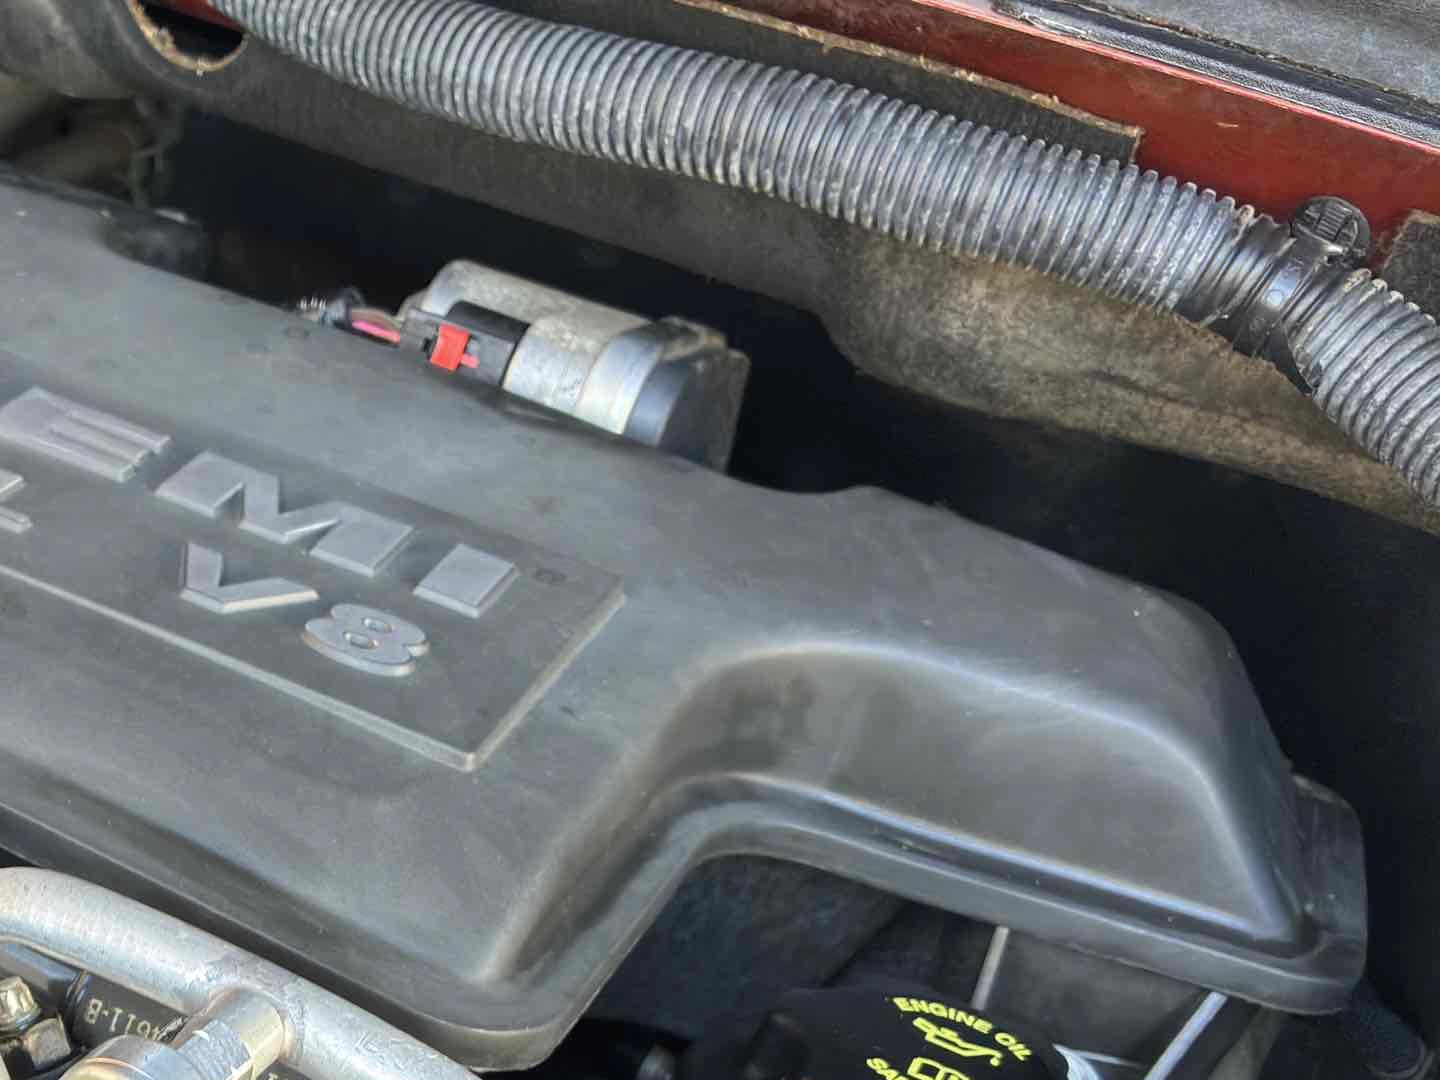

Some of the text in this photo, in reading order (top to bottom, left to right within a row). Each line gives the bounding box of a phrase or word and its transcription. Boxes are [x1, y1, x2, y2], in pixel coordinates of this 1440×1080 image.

[180, 540, 431, 679] V8
[893, 996, 1033, 1062] ENGINE OIL
